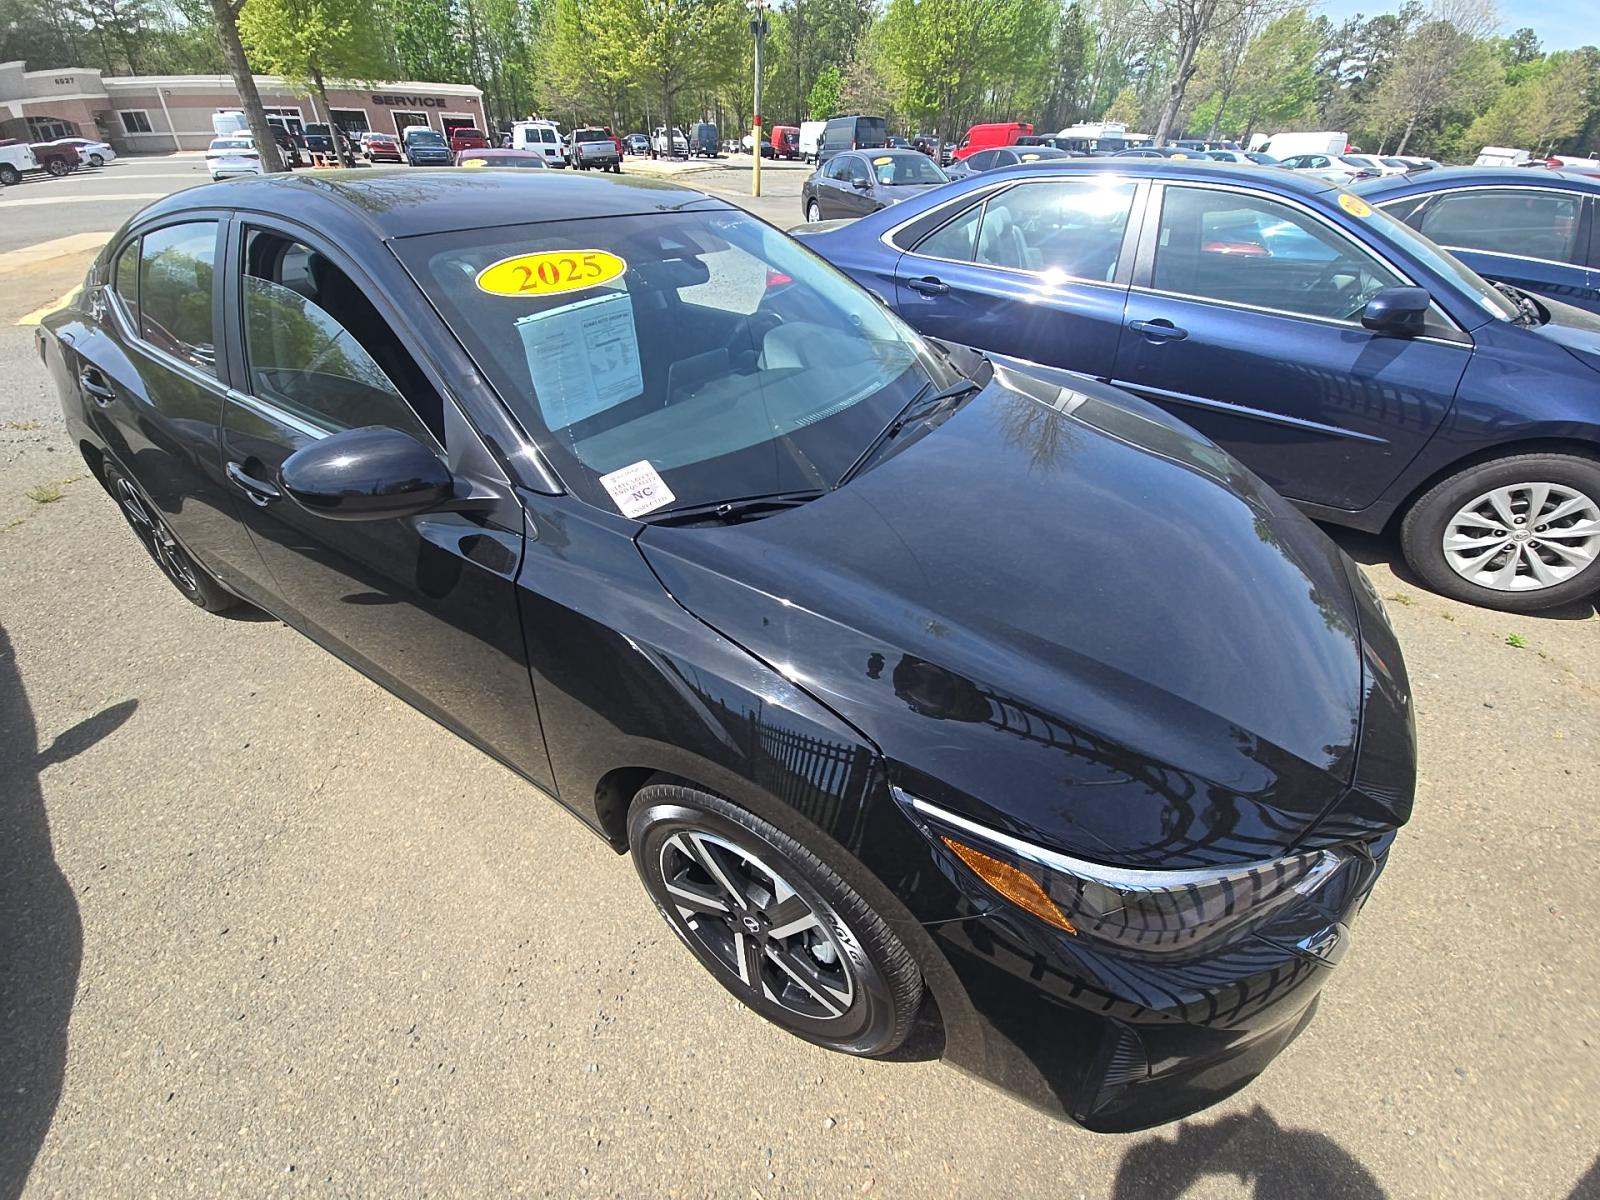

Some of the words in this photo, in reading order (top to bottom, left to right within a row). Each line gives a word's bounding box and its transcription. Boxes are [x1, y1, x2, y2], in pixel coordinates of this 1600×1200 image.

[371, 95, 447, 108] SERVICE
[512, 254, 603, 292] 2025
[631, 487, 653, 501] NC
